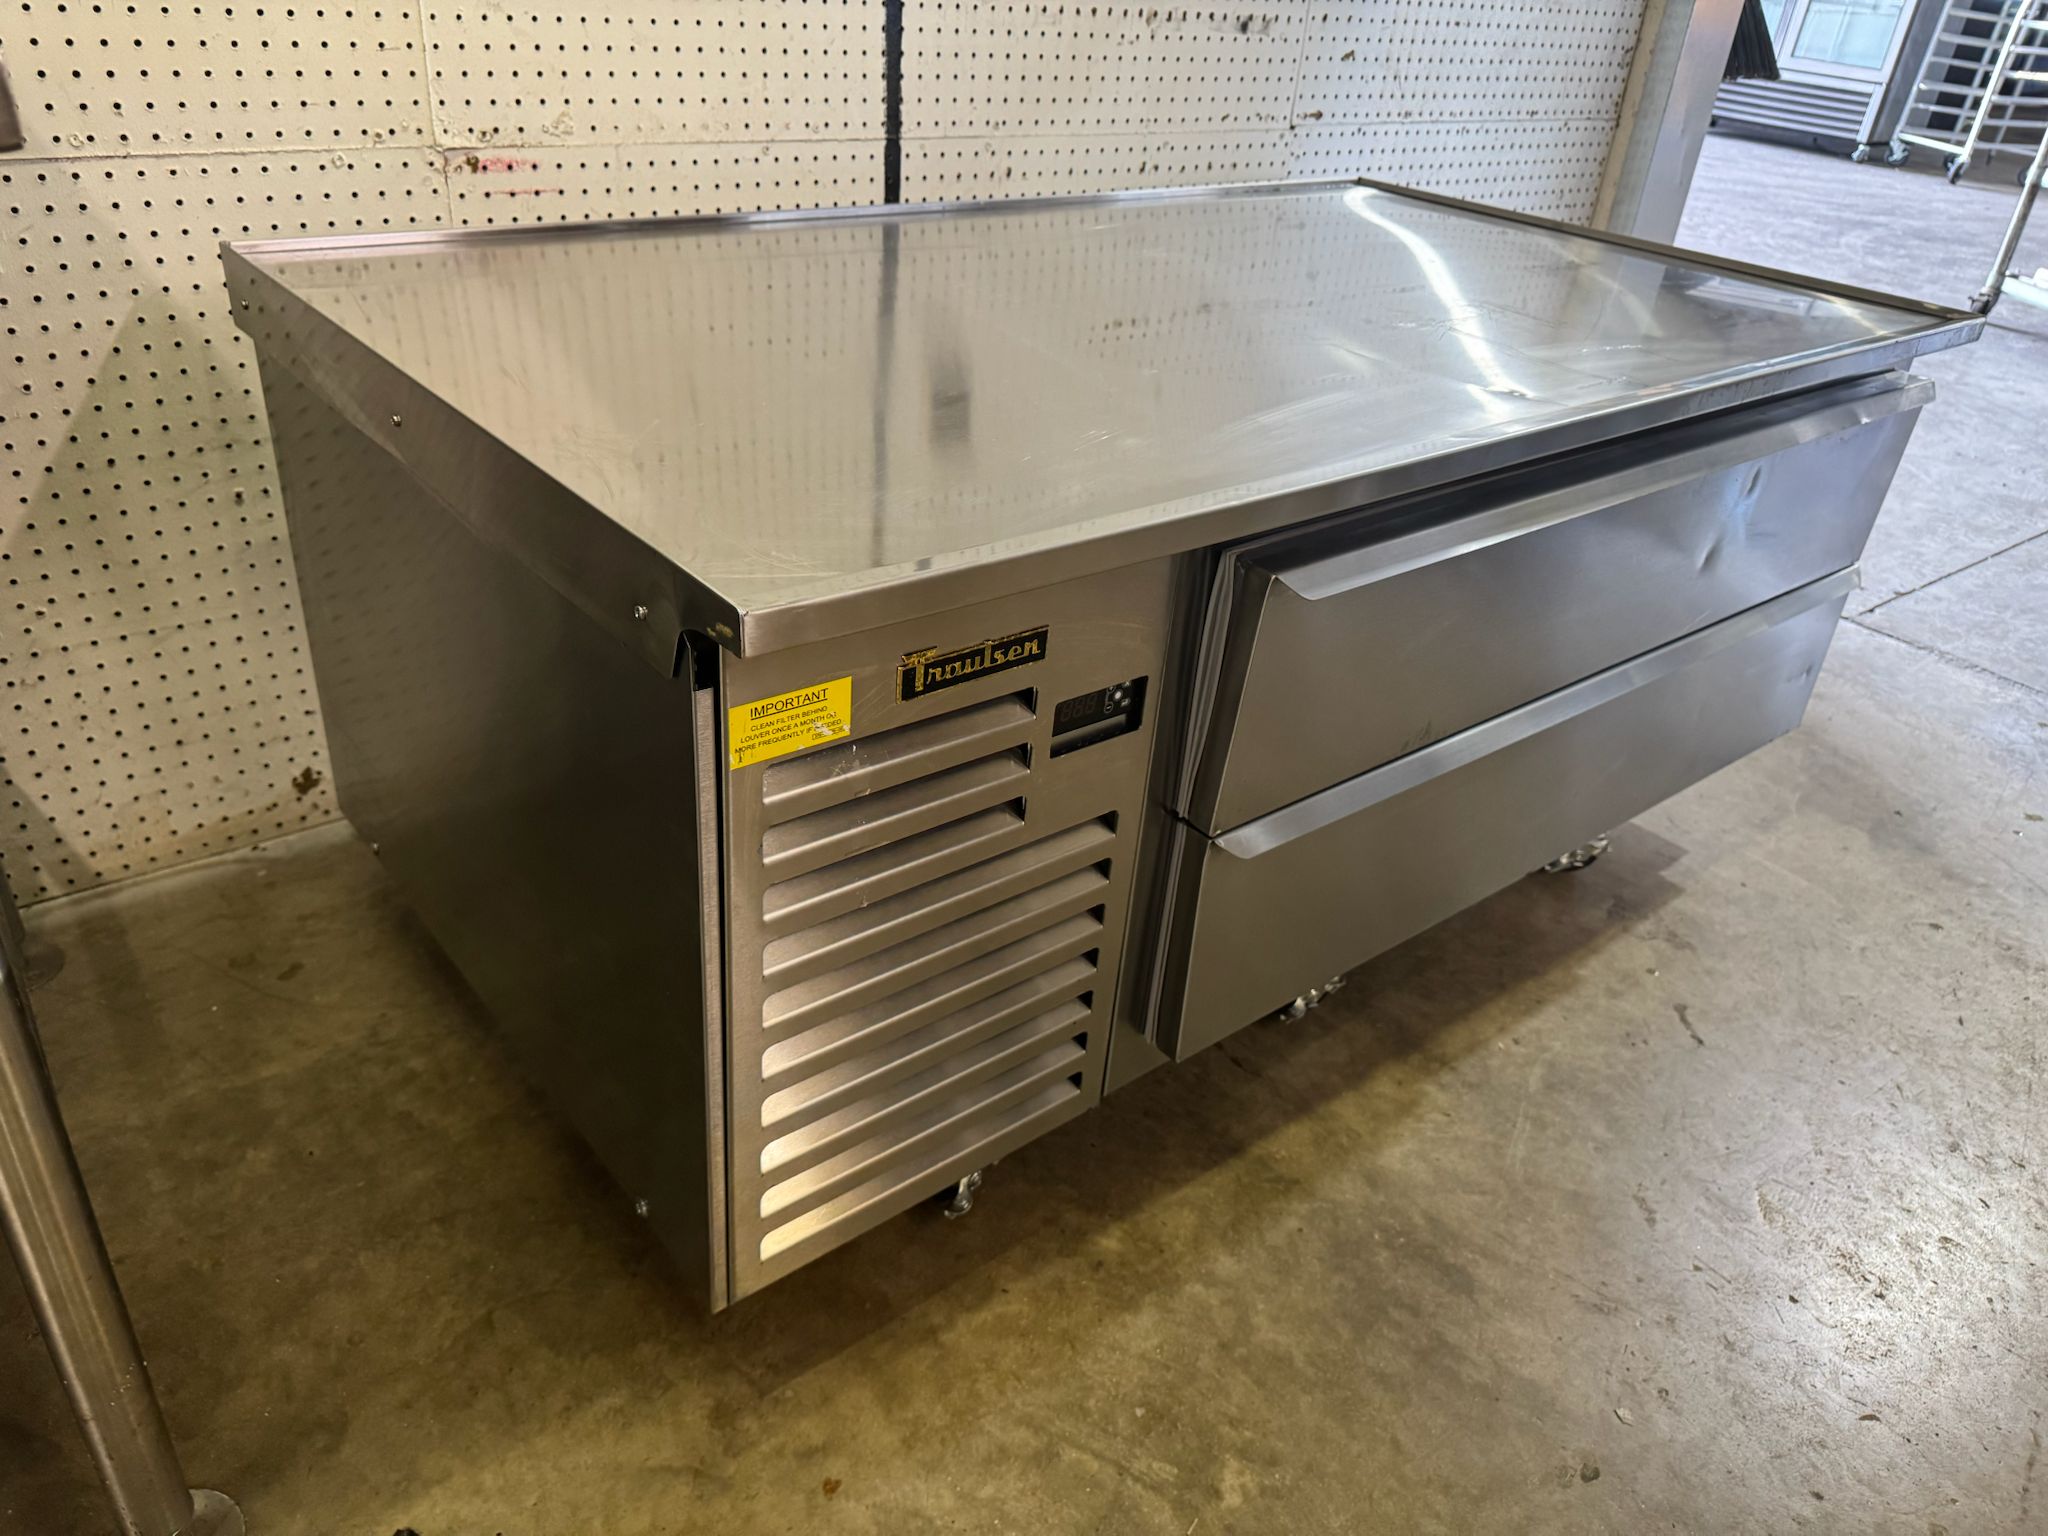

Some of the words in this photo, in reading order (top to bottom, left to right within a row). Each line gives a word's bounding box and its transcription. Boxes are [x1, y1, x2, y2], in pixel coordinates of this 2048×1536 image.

[901, 637, 1042, 693] Traulsen
[750, 688, 828, 718] IMPORTANT
[740, 730, 770, 744] LOUVER
[772, 724, 792, 735] ONCE
[793, 721, 799, 729] A
[800, 714, 825, 727] MONTH
[750, 720, 775, 732] CLEAN
[776, 713, 800, 725] FILTER
[802, 705, 828, 718] BEHIND
[734, 742, 757, 754] MORE
[758, 730, 805, 748] FREQUENTLY
[814, 718, 842, 732] DED
